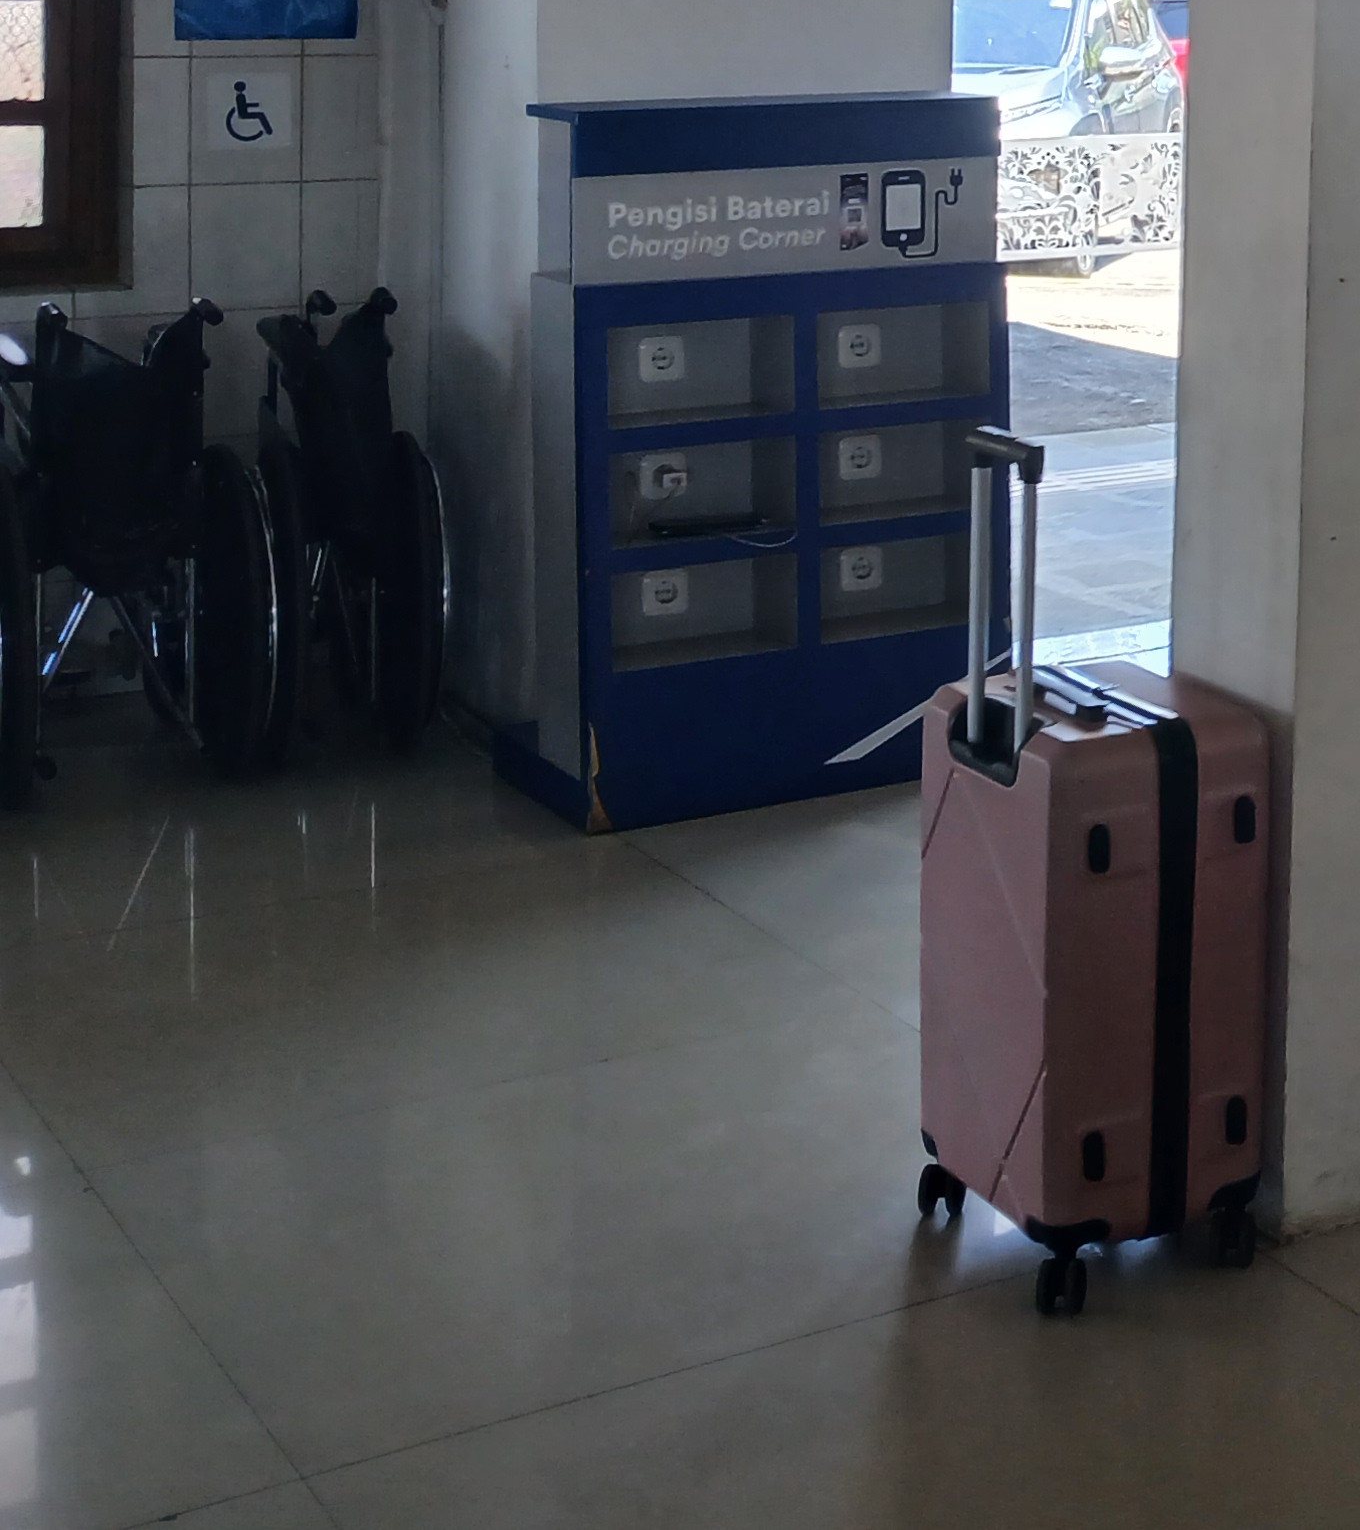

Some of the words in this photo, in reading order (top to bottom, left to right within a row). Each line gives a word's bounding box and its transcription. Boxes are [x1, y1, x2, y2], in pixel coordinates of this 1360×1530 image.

[608, 196, 717, 231] Pengisi
[727, 189, 830, 221] Baterai
[607, 230, 730, 261] Charging
[738, 226, 827, 251] Corner
